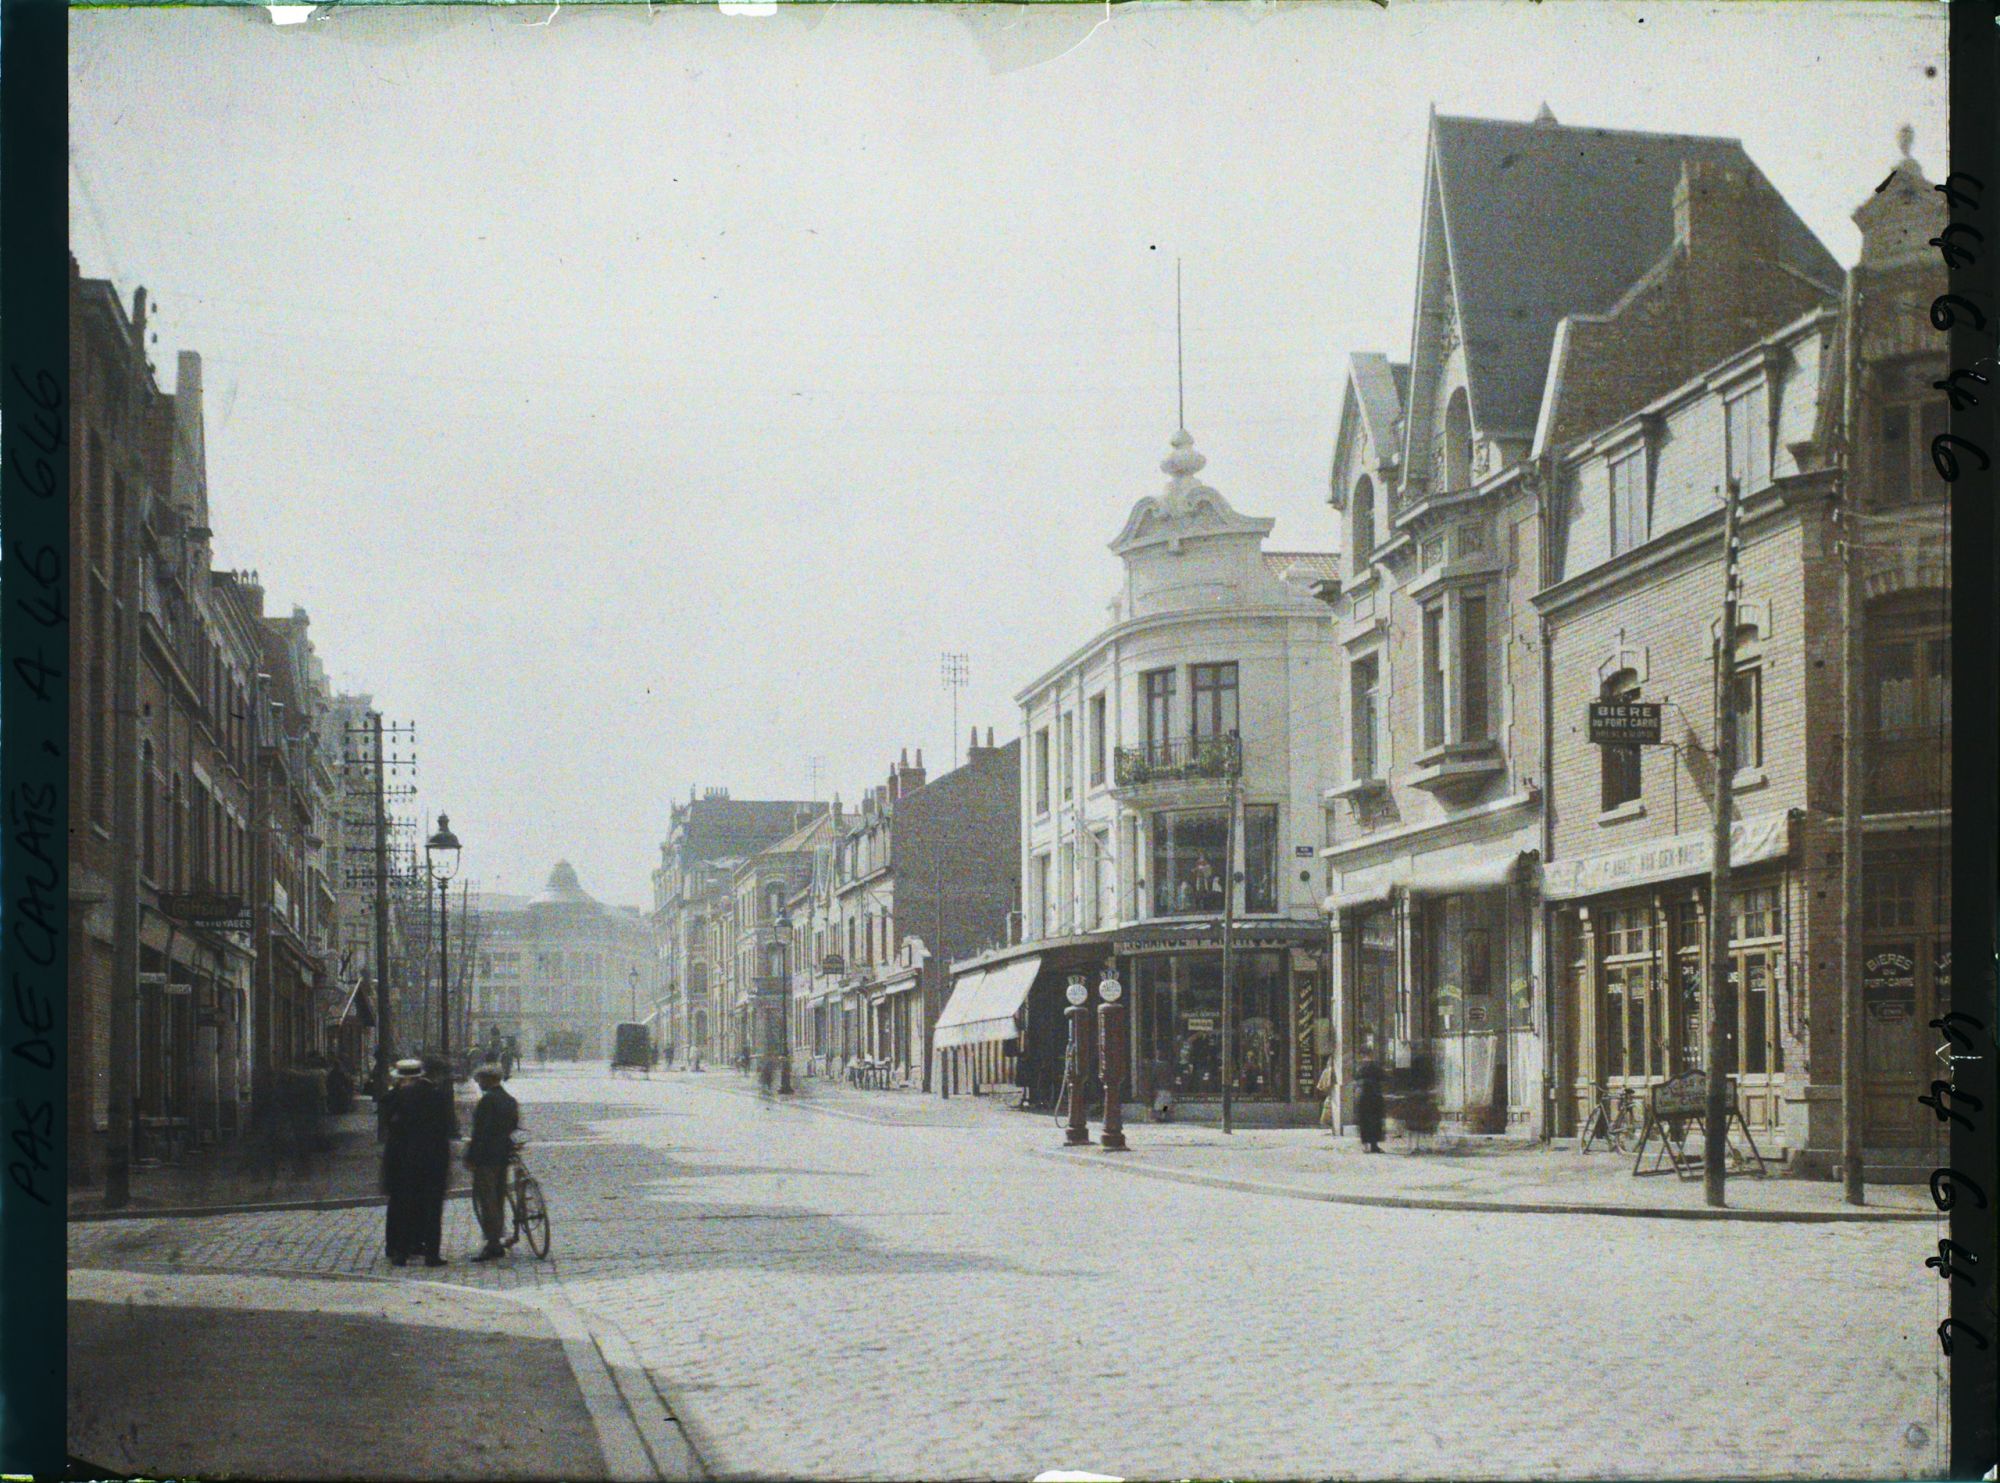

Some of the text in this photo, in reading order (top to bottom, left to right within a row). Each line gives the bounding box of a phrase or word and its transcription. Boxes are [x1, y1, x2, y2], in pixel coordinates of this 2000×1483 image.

[1597, 706, 1652, 717] BIERE
[1865, 953, 1914, 972] BIERES
[10, 972, 55, 1071] DE
[9, 1097, 54, 1207] PAS
